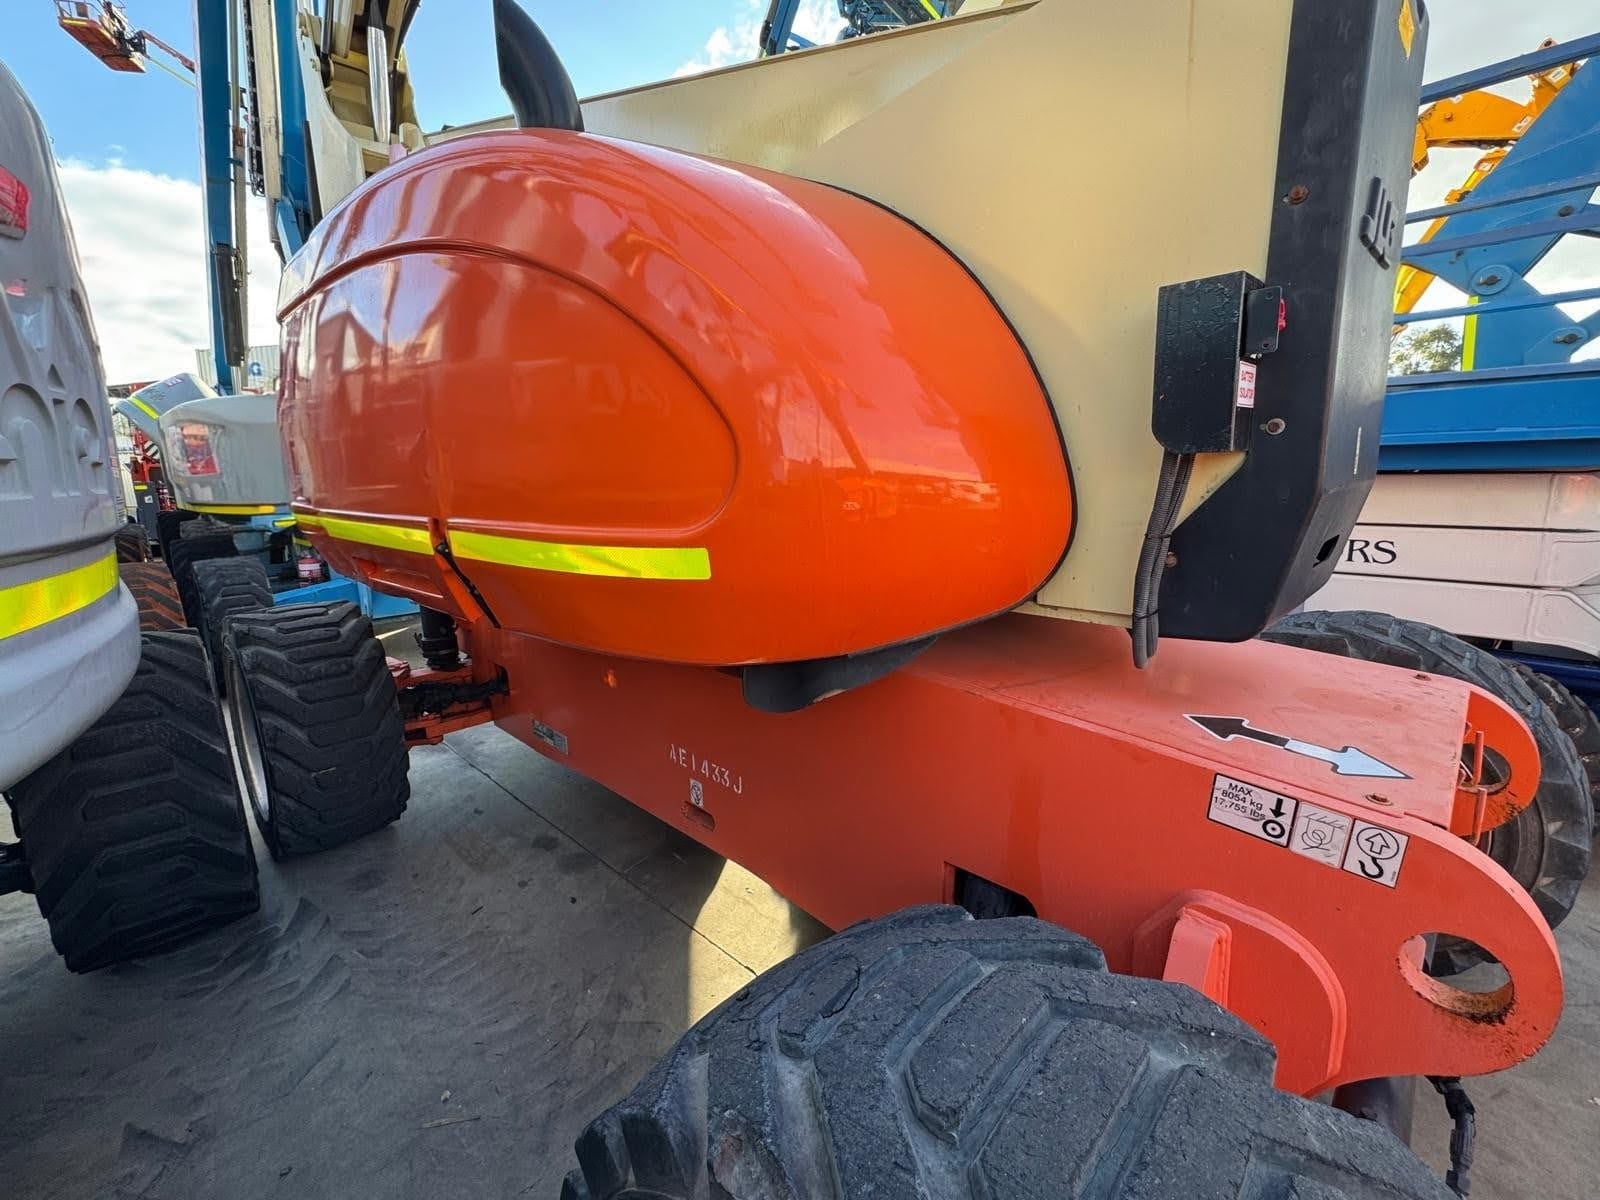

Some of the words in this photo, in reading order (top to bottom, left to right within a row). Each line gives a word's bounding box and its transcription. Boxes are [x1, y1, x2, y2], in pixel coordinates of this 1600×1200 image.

[669, 743, 742, 794] AE1433J
[1228, 782, 1253, 797] MAX
[1214, 796, 1247, 814] 17,755
[1221, 789, 1246, 804] 8054
[1249, 799, 1263, 811] kg
